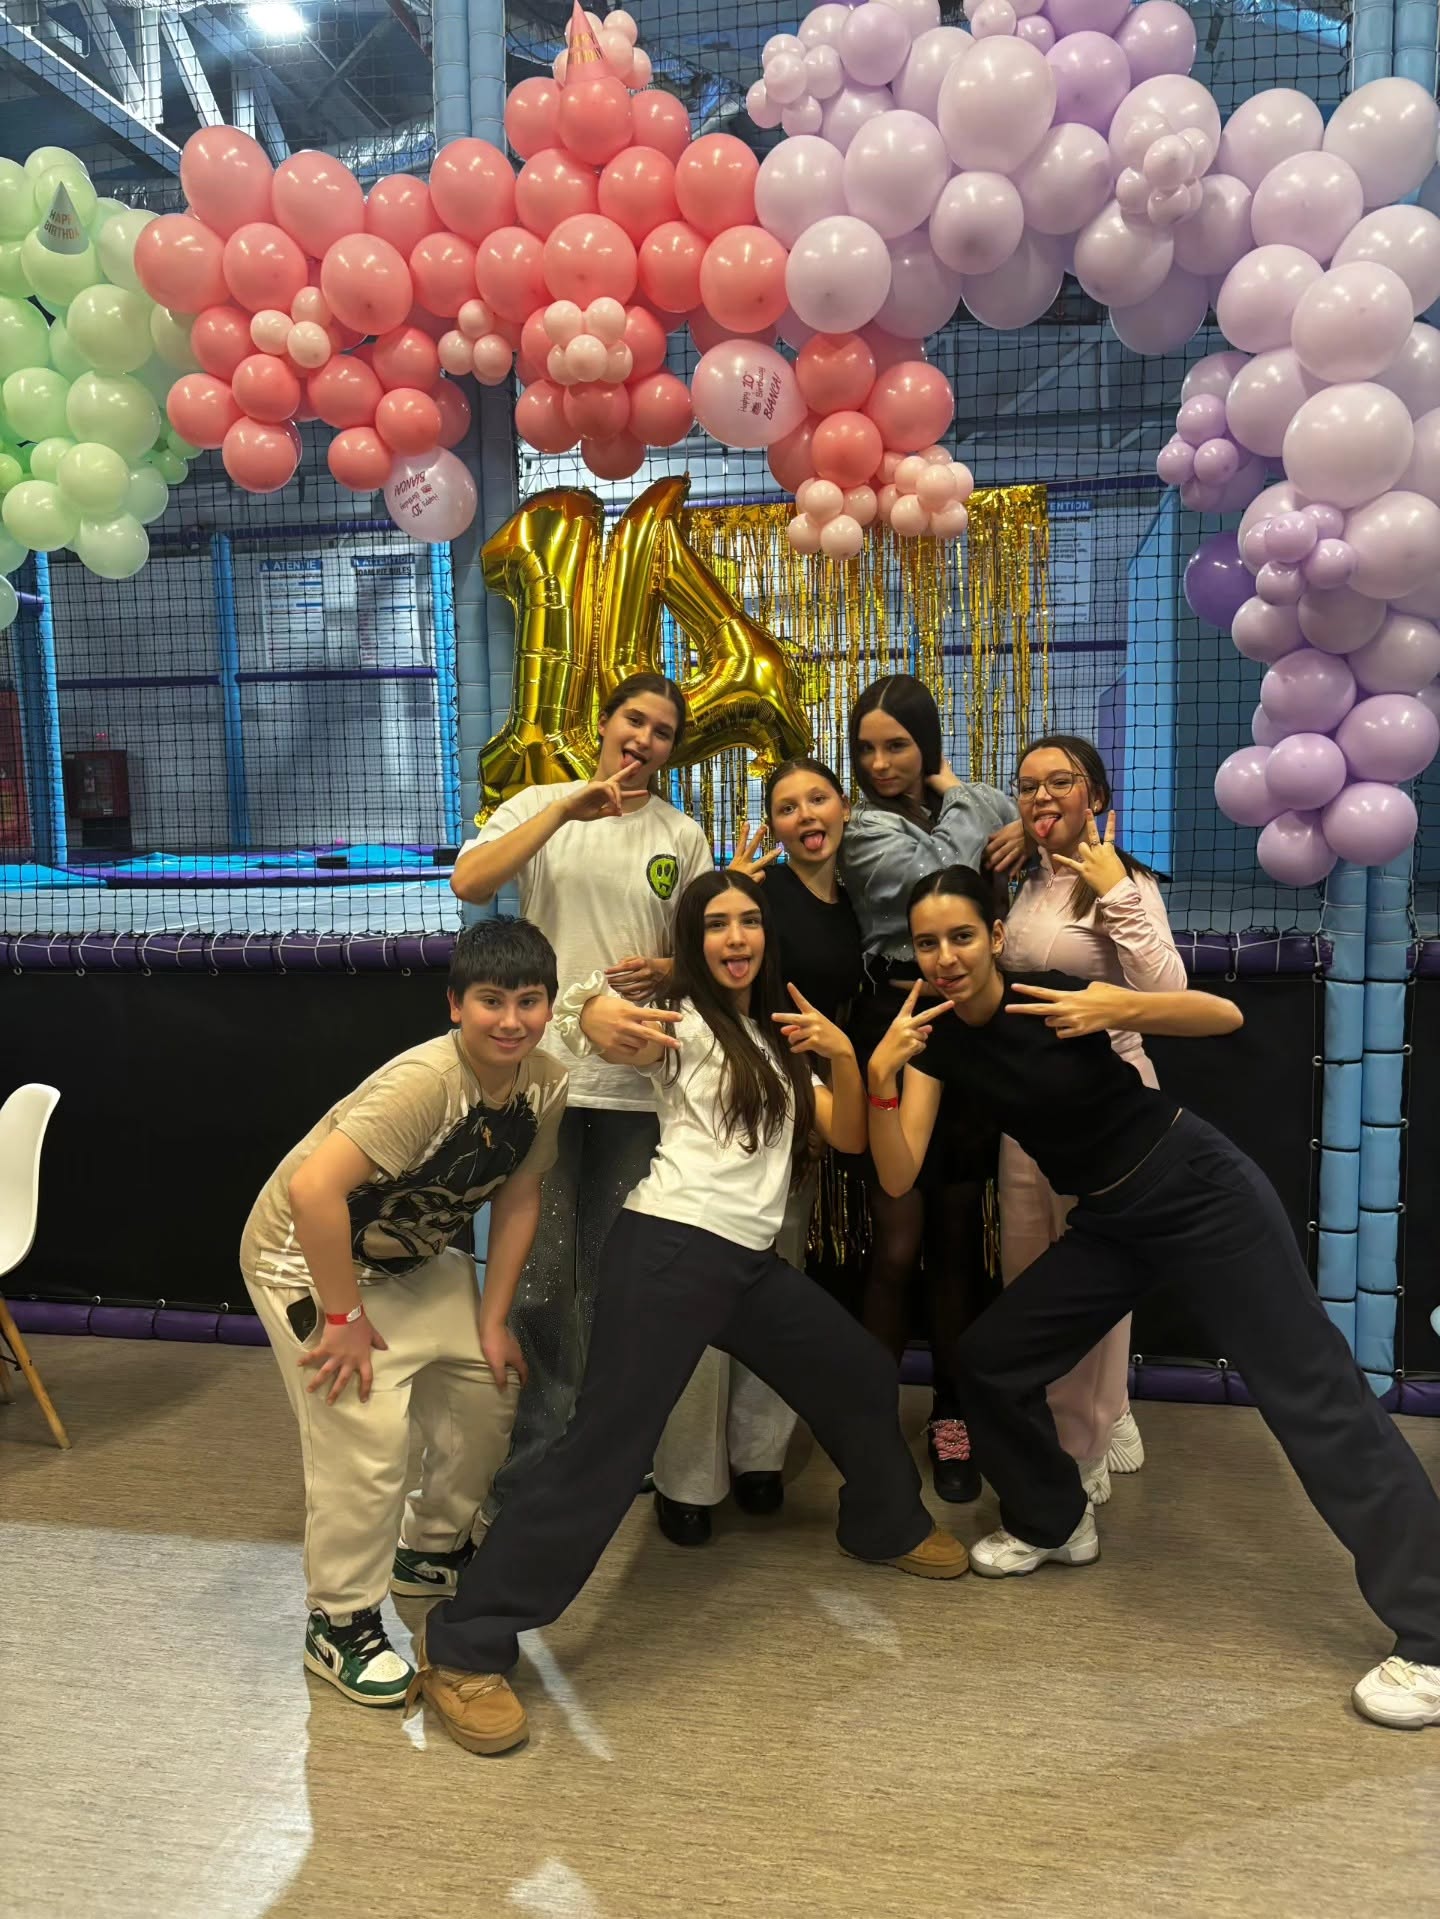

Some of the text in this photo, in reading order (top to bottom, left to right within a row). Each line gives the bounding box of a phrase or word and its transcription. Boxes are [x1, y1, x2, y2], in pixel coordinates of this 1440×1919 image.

[49, 209, 74, 225] HAPP
[43, 219, 80, 240] BIRTHDA
[763, 371, 782, 421] BIANCA!
[394, 470, 426, 497] BIANCA!
[1049, 501, 1090, 510] ENTION
